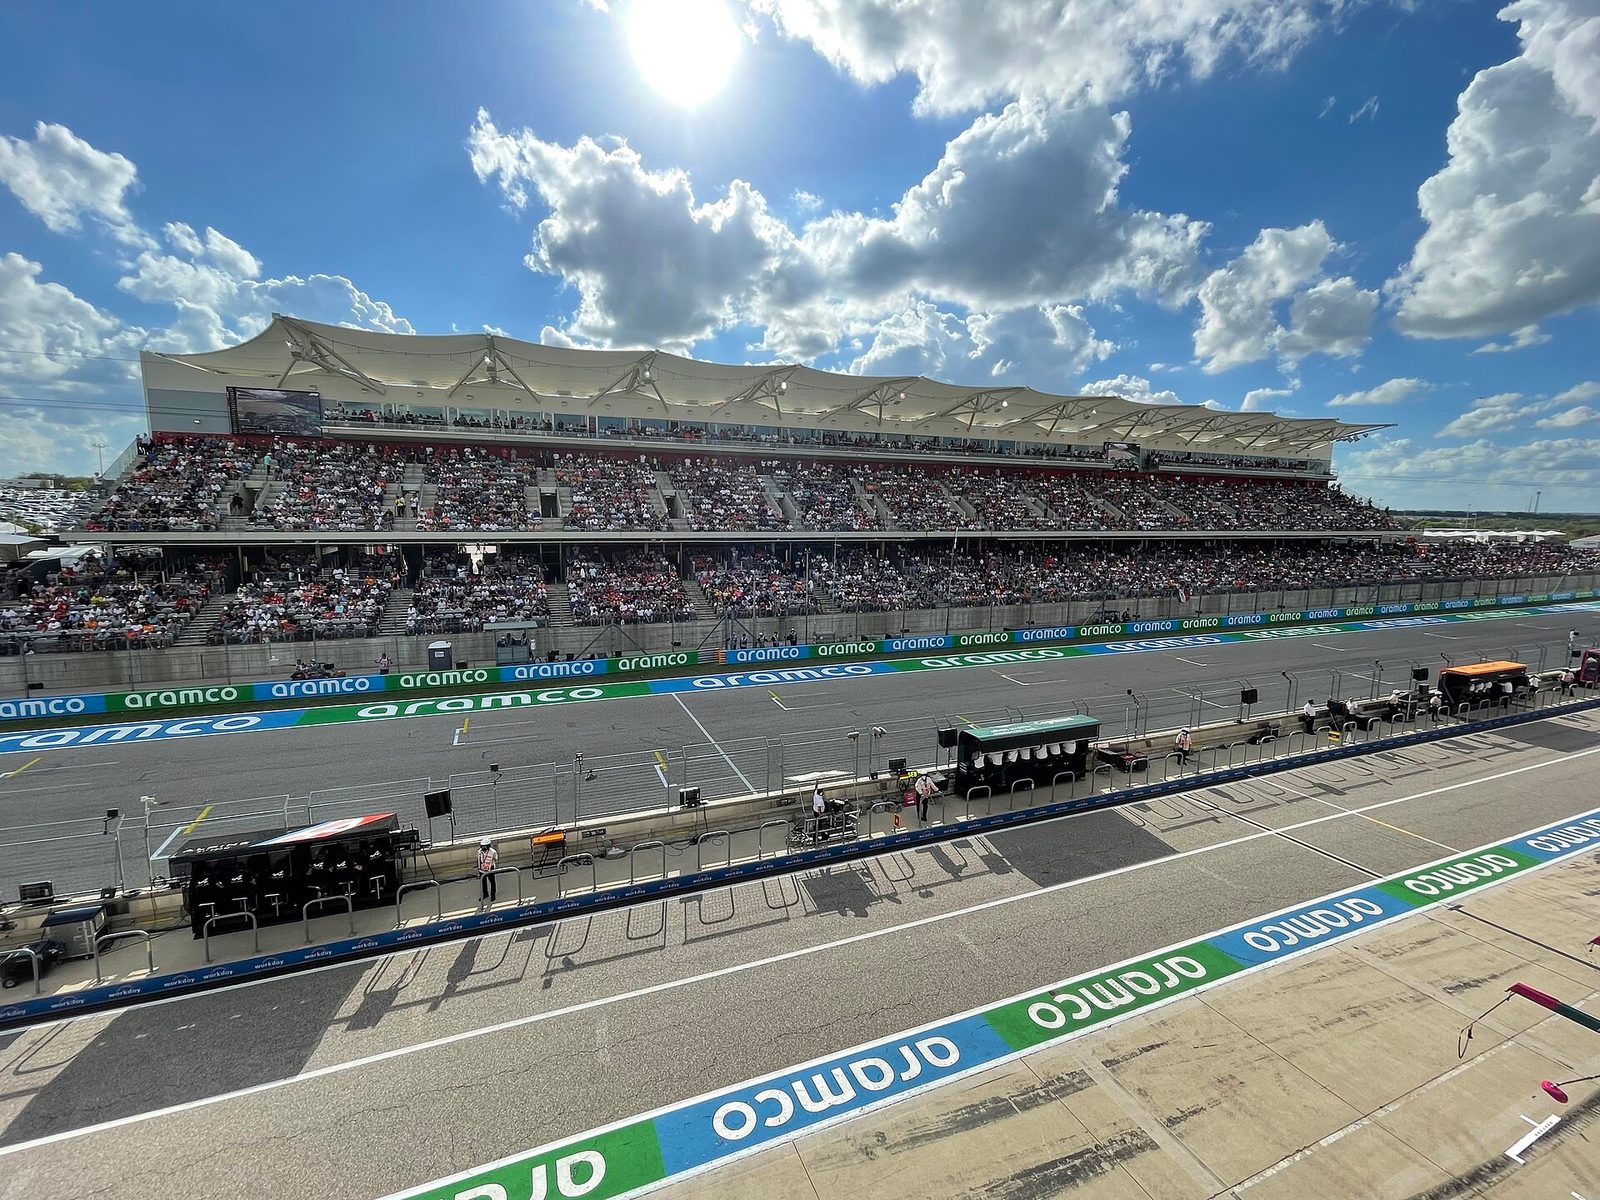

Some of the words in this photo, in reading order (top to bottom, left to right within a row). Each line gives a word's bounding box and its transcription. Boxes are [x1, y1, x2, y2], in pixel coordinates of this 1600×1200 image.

[1413, 602, 1439, 611] aramco
[1444, 600, 1469, 609] aramco
[1473, 597, 1496, 606] aramco
[1308, 609, 1338, 619] aramco
[1345, 606, 1374, 617] aramco
[1380, 604, 1407, 614] aramco
[1182, 617, 1218, 630] aramco
[1228, 614, 1261, 625] aramco
[1270, 612, 1301, 622] aramco
[1080, 623, 1122, 636] aramco
[1133, 620, 1172, 633] aramco
[960, 631, 1008, 645] aramco
[1022, 628, 1067, 641] aramco
[818, 641, 875, 656] aramco
[892, 637, 945, 650] aramco
[1105, 636, 1221, 652] aramco
[736, 647, 799, 662] aramco
[921, 649, 1064, 668] aramco
[617, 653, 688, 670] aramco
[514, 661, 594, 679] aramco
[691, 664, 873, 689] aramco
[399, 669, 488, 688] aramco
[271, 677, 370, 697] aramco
[124, 686, 238, 708] aramco
[357, 687, 603, 718] aramco
[1403, 854, 1519, 895] aramco
[519, 909, 543, 917] workday
[480, 916, 503, 925] workday
[1243, 897, 1384, 953] aramco
[439, 924, 463, 933] workday
[397, 933, 422, 941] workday
[352, 941, 378, 950] workday
[304, 950, 332, 959] workday
[255, 960, 284, 969] workday
[203, 970, 234, 979] workday
[164, 978, 195, 987] workday
[108, 987, 141, 998] workday
[1027, 955, 1207, 1030] aramco
[51, 998, 85, 1008] workday
[712, 1036, 962, 1141] aramco
